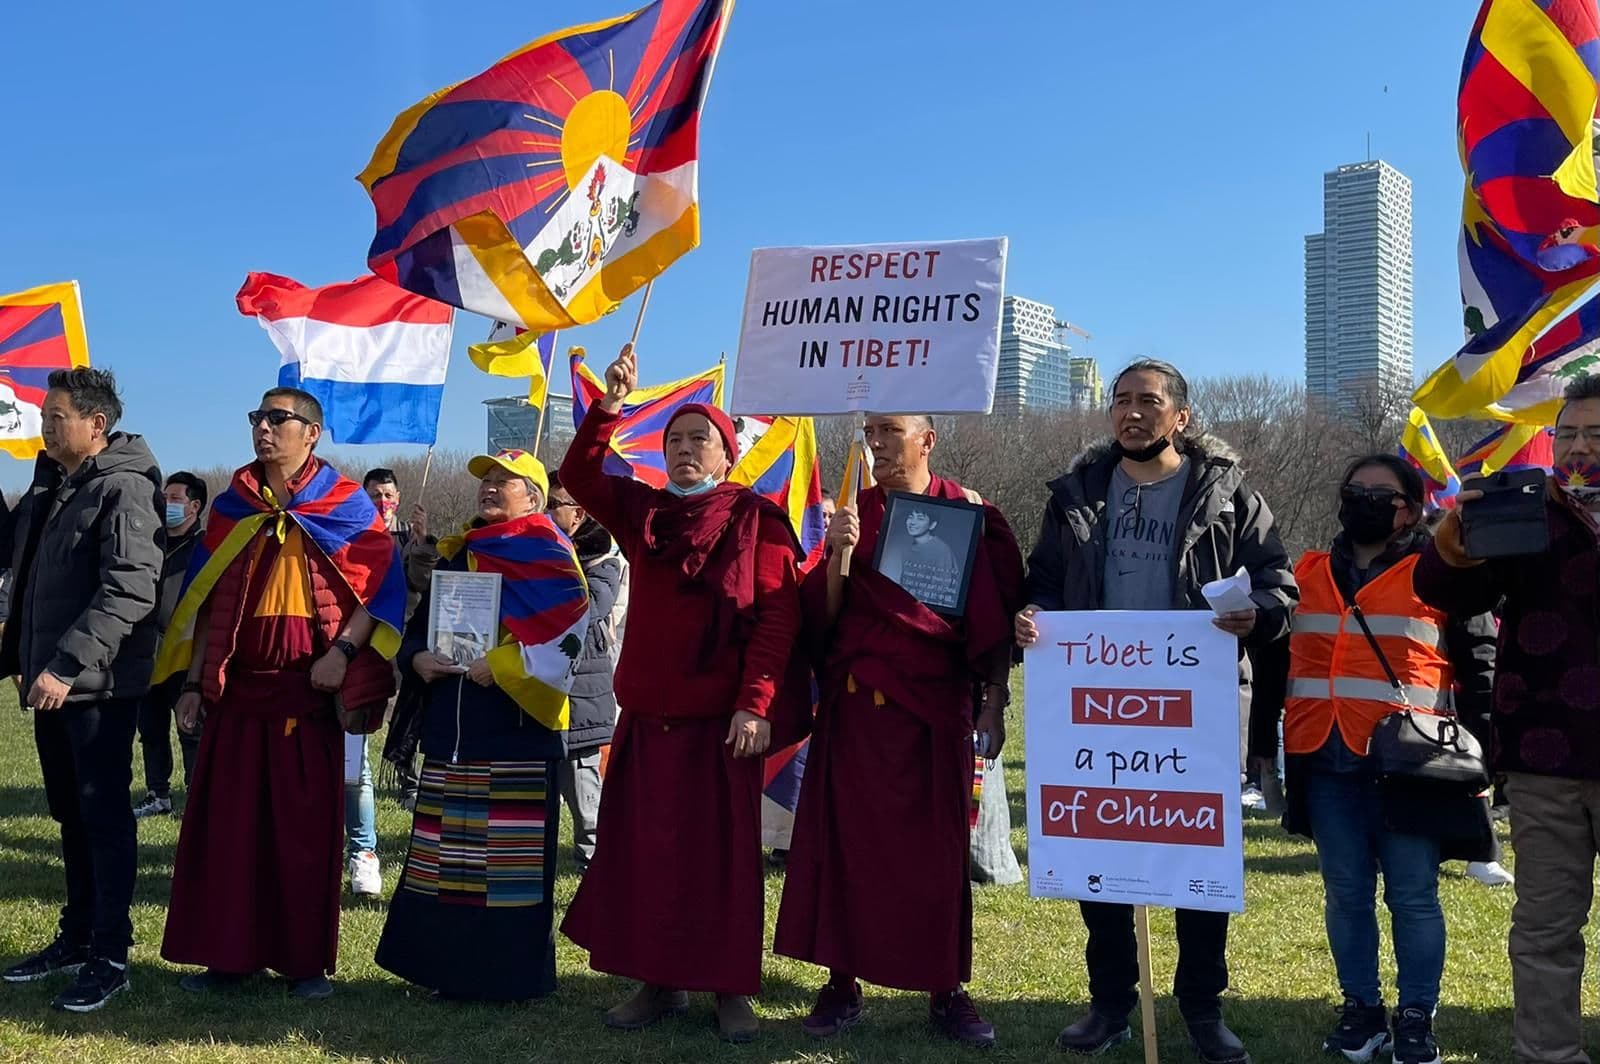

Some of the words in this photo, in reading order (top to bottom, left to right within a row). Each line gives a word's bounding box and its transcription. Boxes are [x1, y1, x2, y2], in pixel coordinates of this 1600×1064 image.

[810, 250, 941, 283] RESPECT
[761, 295, 864, 327] HUMAN
[872, 293, 981, 324] RIGHTS
[799, 340, 828, 368] IN
[839, 339, 930, 368] TIBET!
[1057, 633, 1153, 667] Tibet
[1166, 634, 1200, 667] is
[1084, 693, 1181, 721] NOT
[1075, 748, 1093, 770] a
[1106, 747, 1187, 785] part
[1048, 790, 1088, 833] of
[1096, 793, 1216, 830] China
